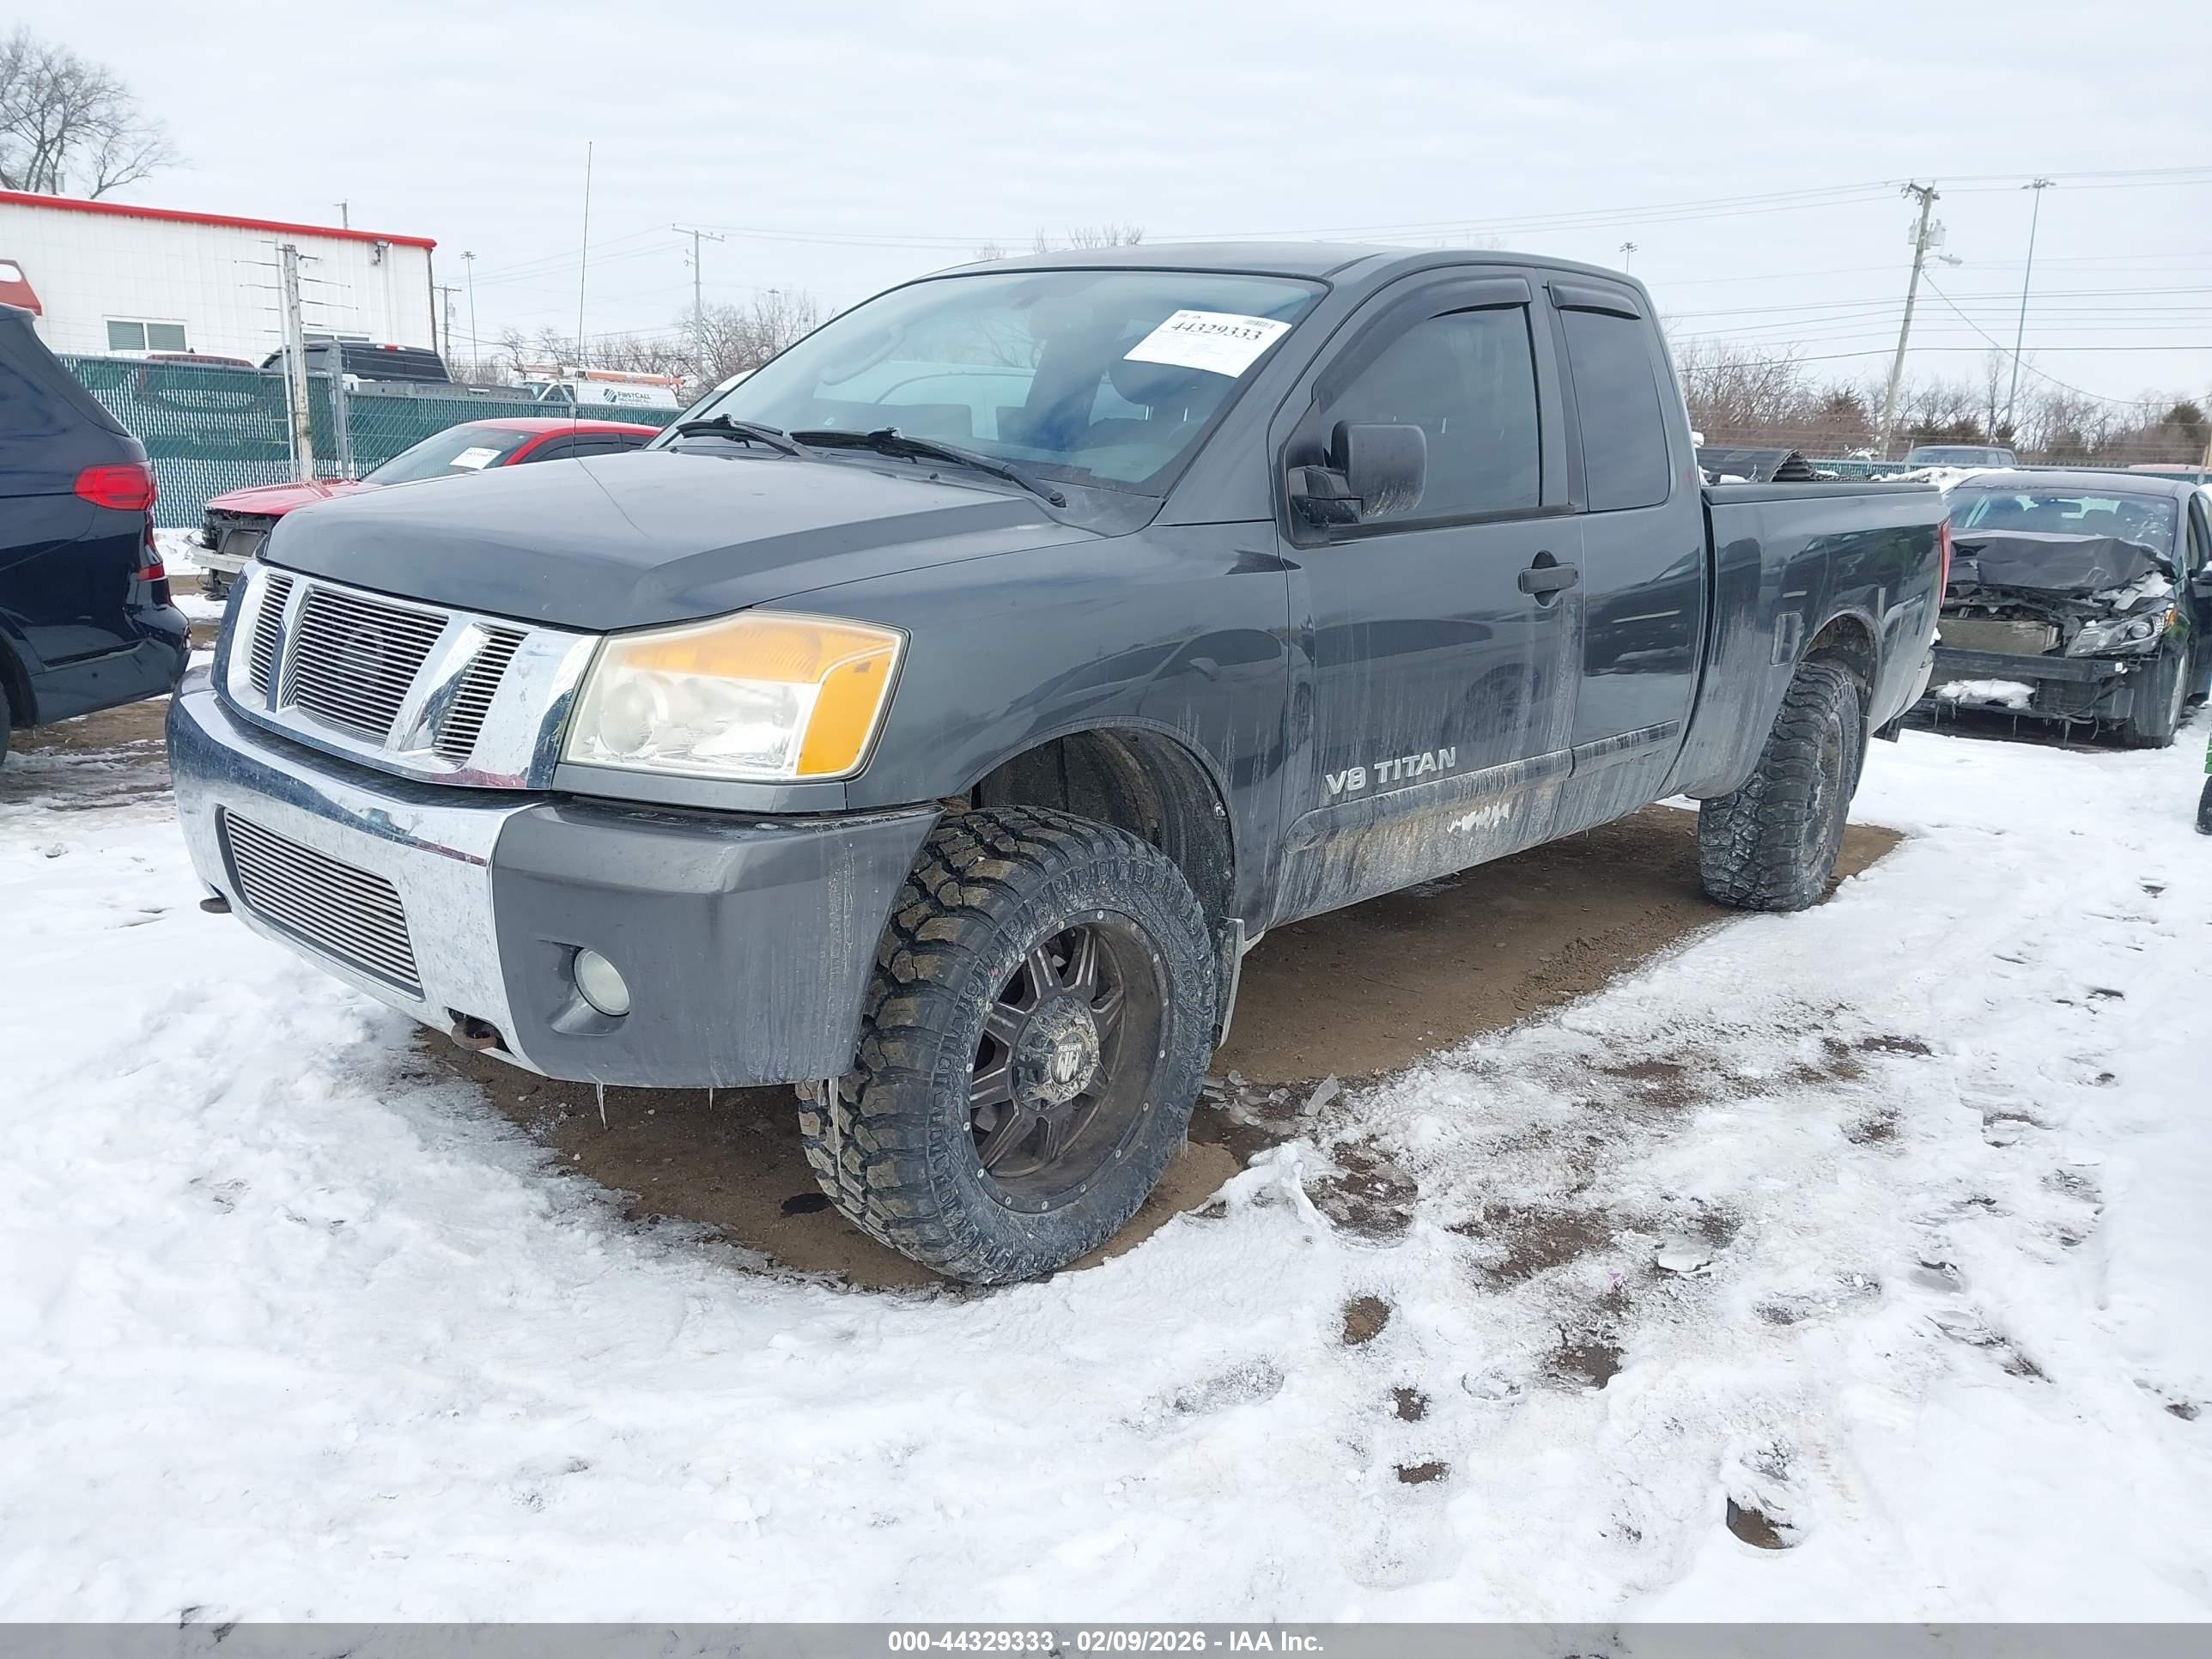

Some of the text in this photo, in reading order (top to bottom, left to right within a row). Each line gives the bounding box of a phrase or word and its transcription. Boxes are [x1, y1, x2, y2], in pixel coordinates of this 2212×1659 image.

[1171, 321, 1262, 341] 44329333
[1325, 746, 1456, 795] V8 TITAN
